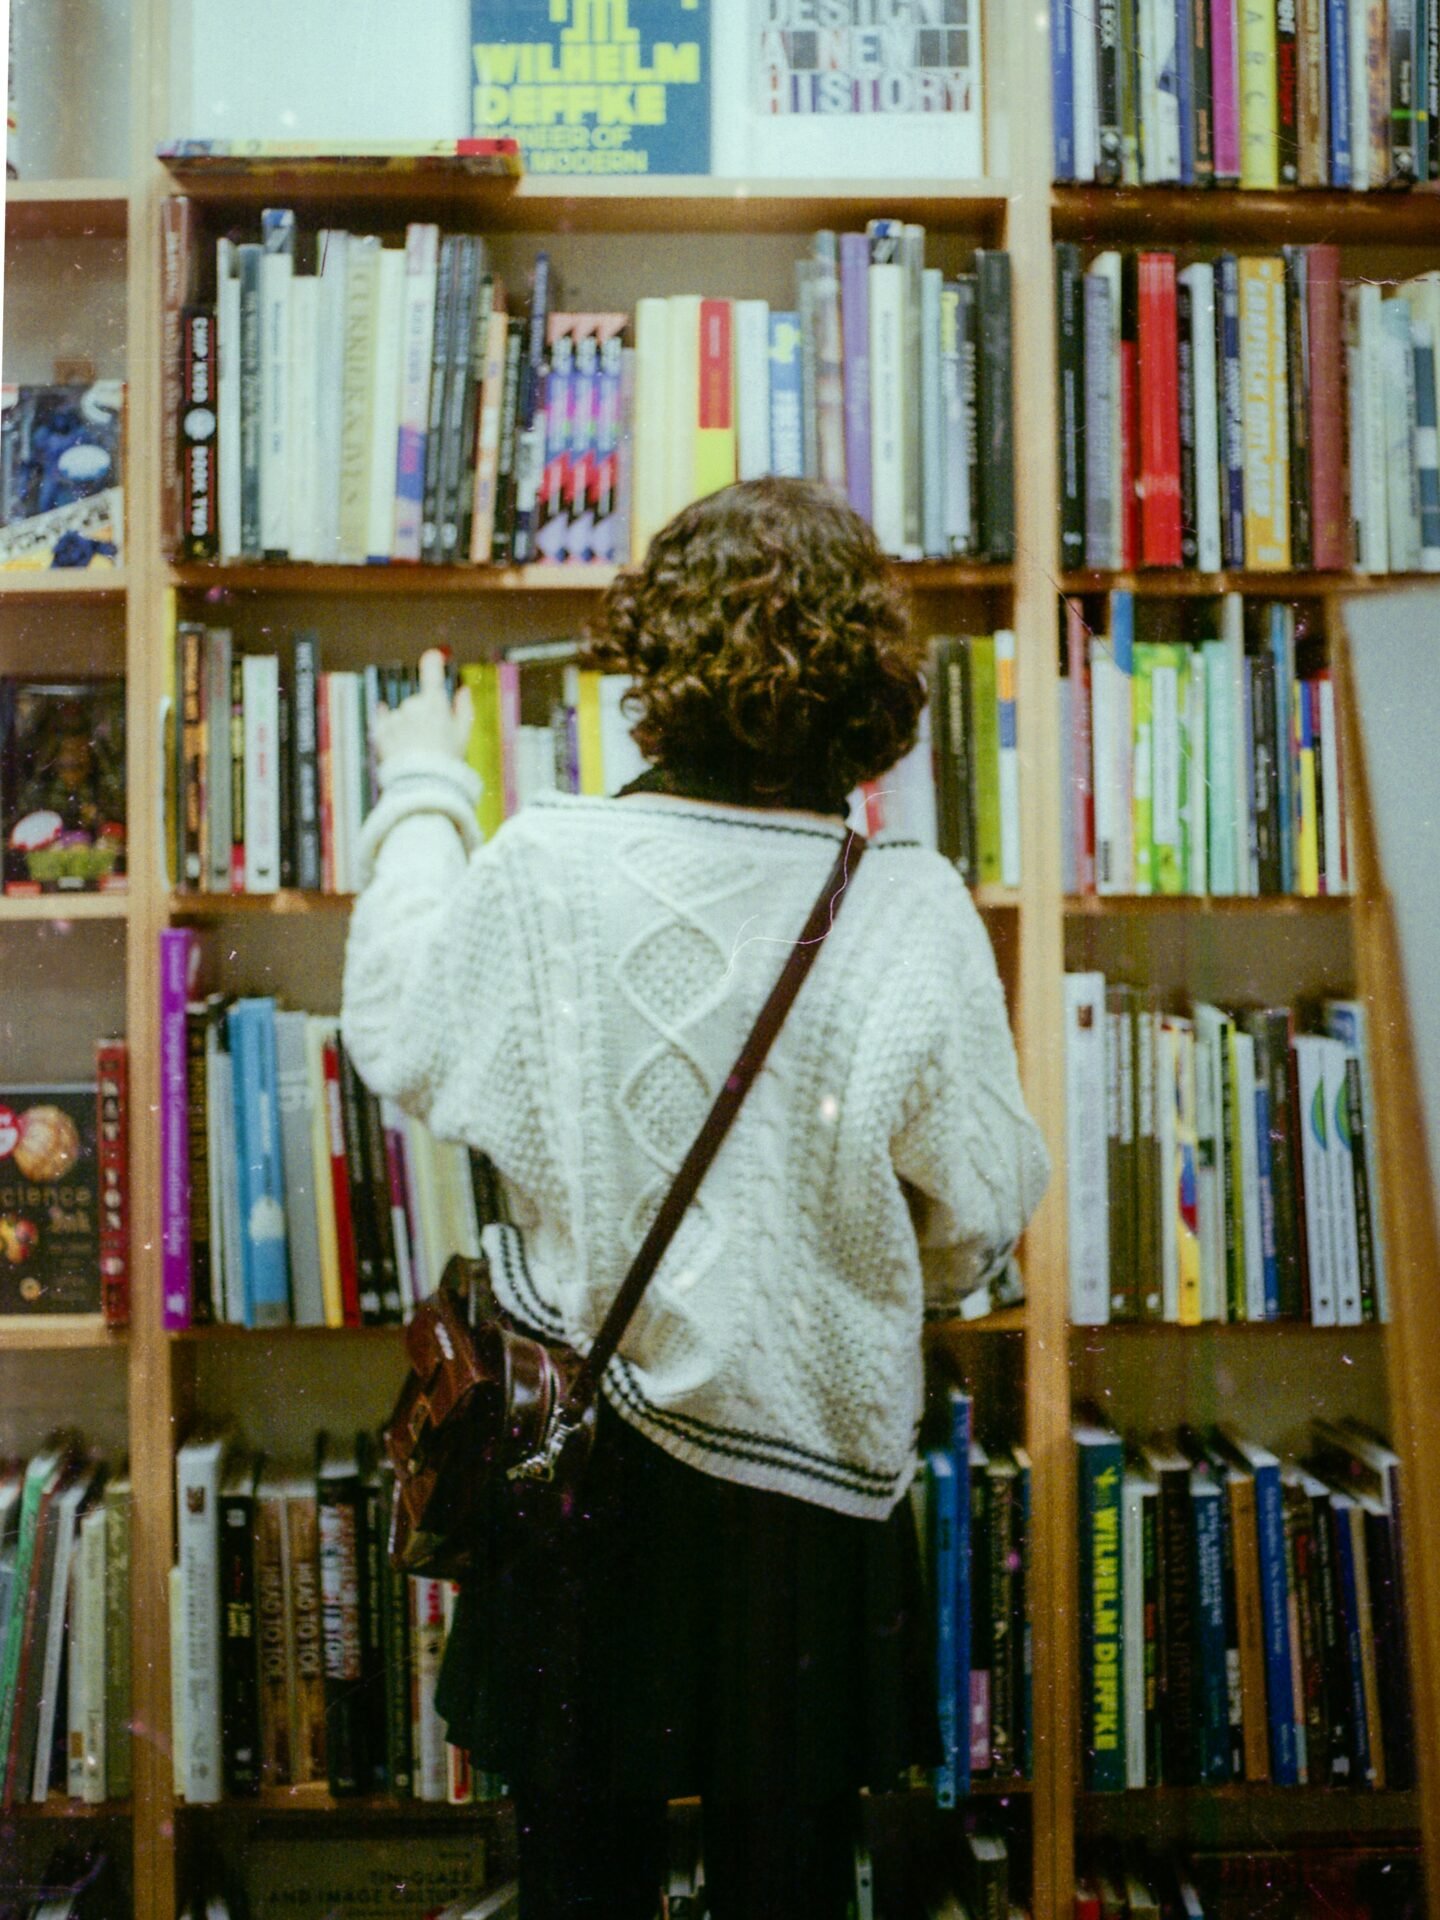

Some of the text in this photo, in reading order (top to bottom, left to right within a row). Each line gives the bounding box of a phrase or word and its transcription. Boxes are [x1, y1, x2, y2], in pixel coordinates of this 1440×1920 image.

[473, 42, 699, 84] WILHELM
[817, 29, 919, 70] NEW
[474, 84, 665, 125] DEFFKE
[761, 70, 970, 113] HISTORY
[591, 125, 632, 149] OF
[530, 149, 649, 174] MODERN
[191, 316, 209, 404] CHIP KIDD
[191, 445, 209, 537] BOOK TWO
[279, 1068, 312, 1112] 16
[260, 1564, 285, 1683] HEAD TO TOE
[296, 1563, 320, 1674] HEAD TO TOE
[1093, 1506, 1118, 1751] WILHELM DEFFKE
[325, 1889, 383, 1903] IMAGE
